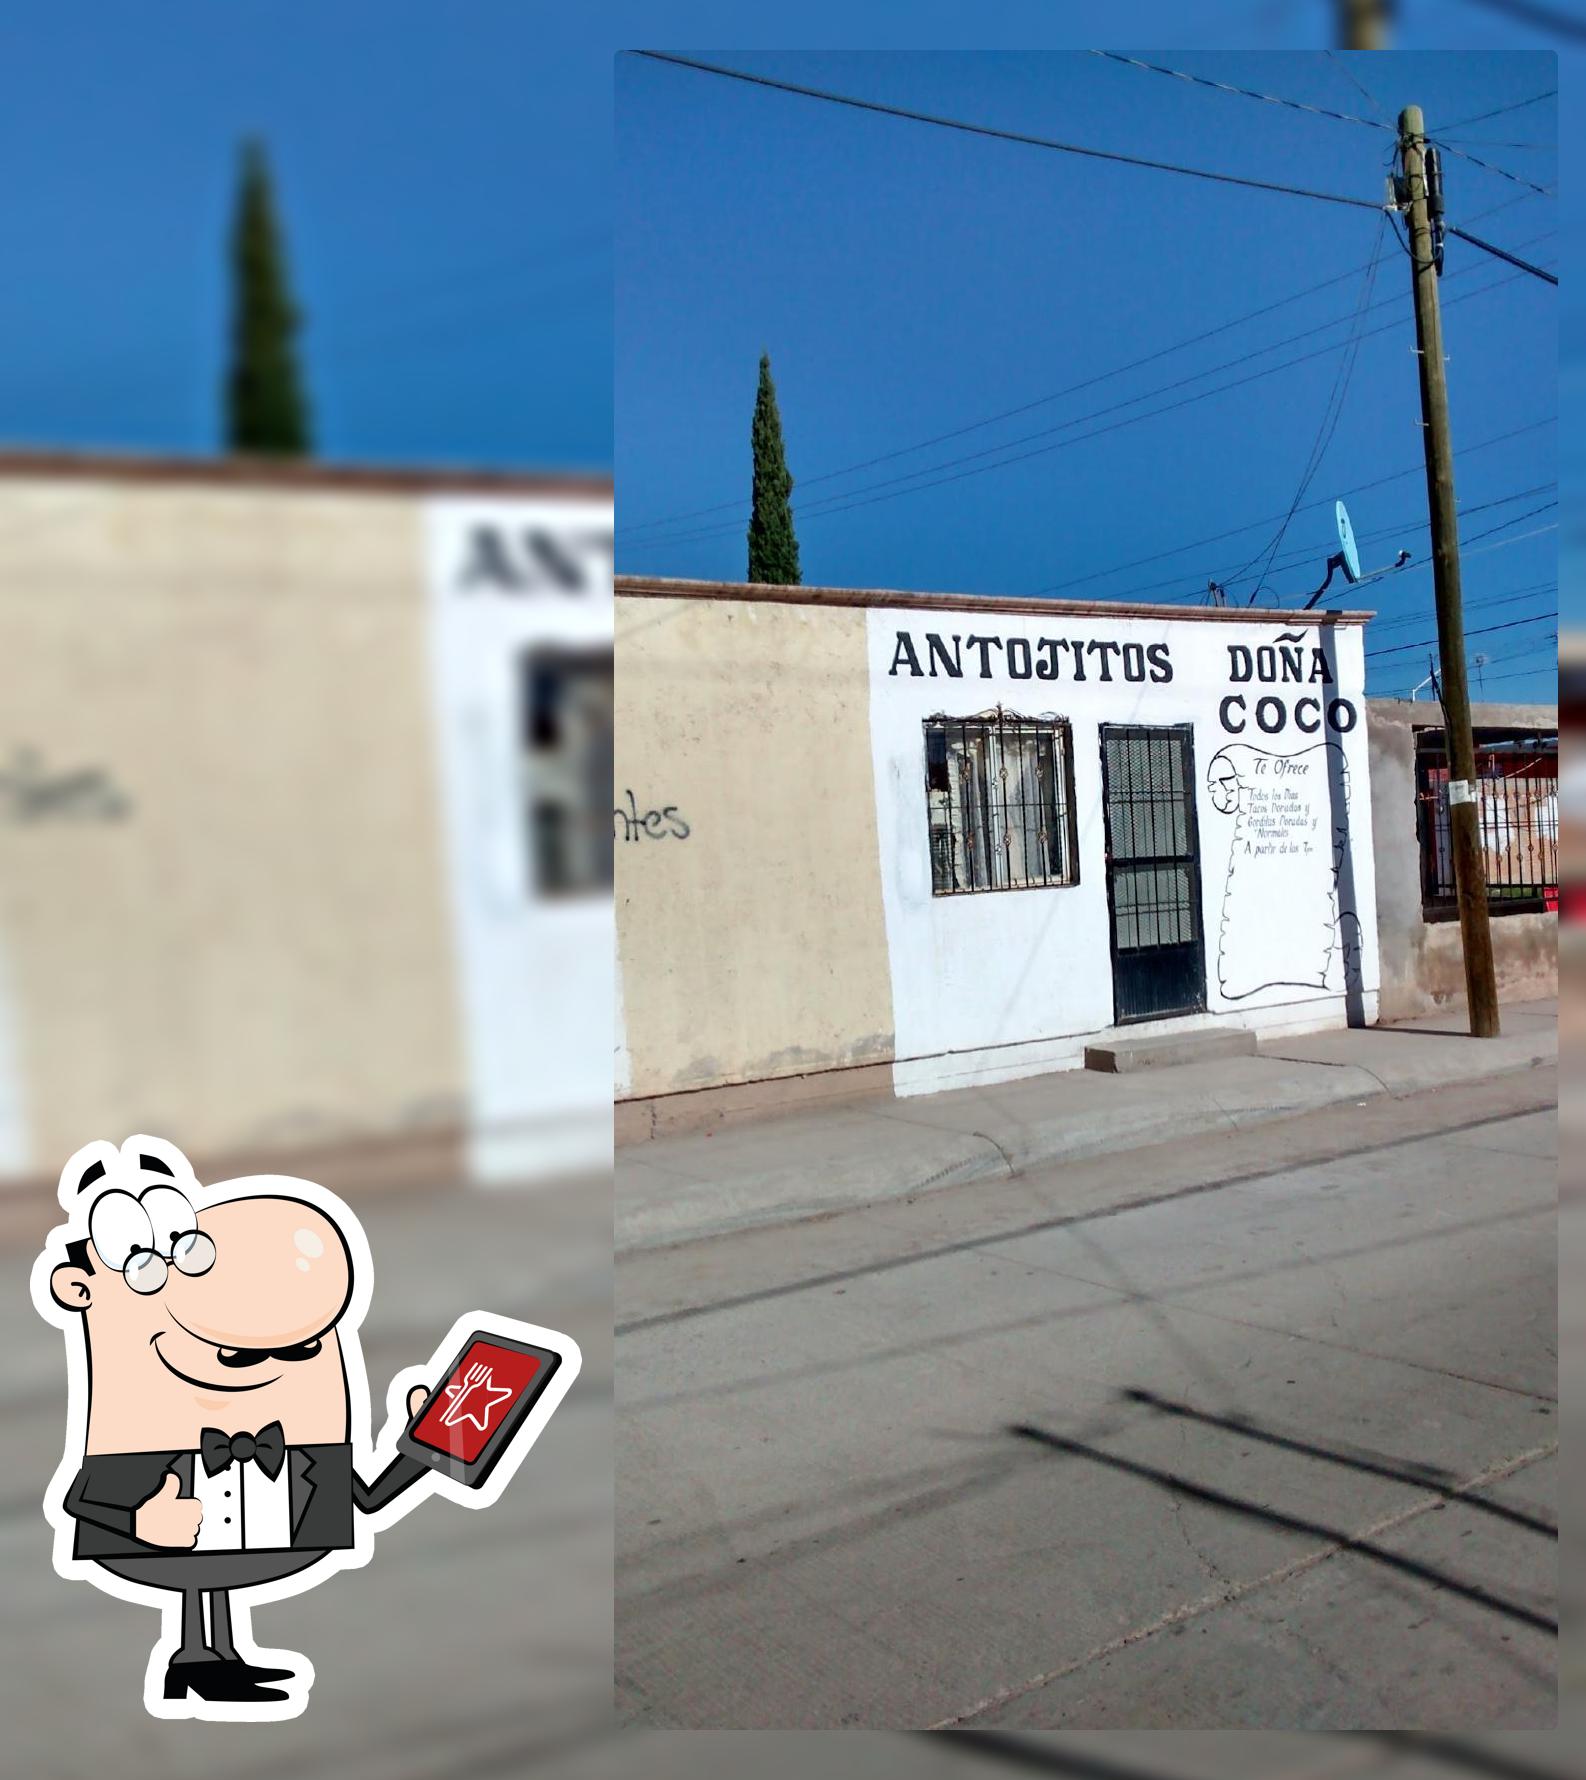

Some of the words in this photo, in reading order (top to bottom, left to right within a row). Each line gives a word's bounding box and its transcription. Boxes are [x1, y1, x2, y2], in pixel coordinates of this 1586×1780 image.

[888, 630, 1174, 683] ANTOJITOS
[1227, 628, 1334, 684] DOÑA
[1219, 694, 1358, 734] COCO
[1253, 758, 1269, 775] Te
[1274, 759, 1309, 779] Ofrece
[1247, 787, 1269, 801] Todos
[1271, 787, 1281, 801] los
[1247, 802, 1268, 814] Tacos
[1304, 802, 1310, 817] y
[1311, 817, 1319, 831] y
[1244, 840, 1252, 855] A
